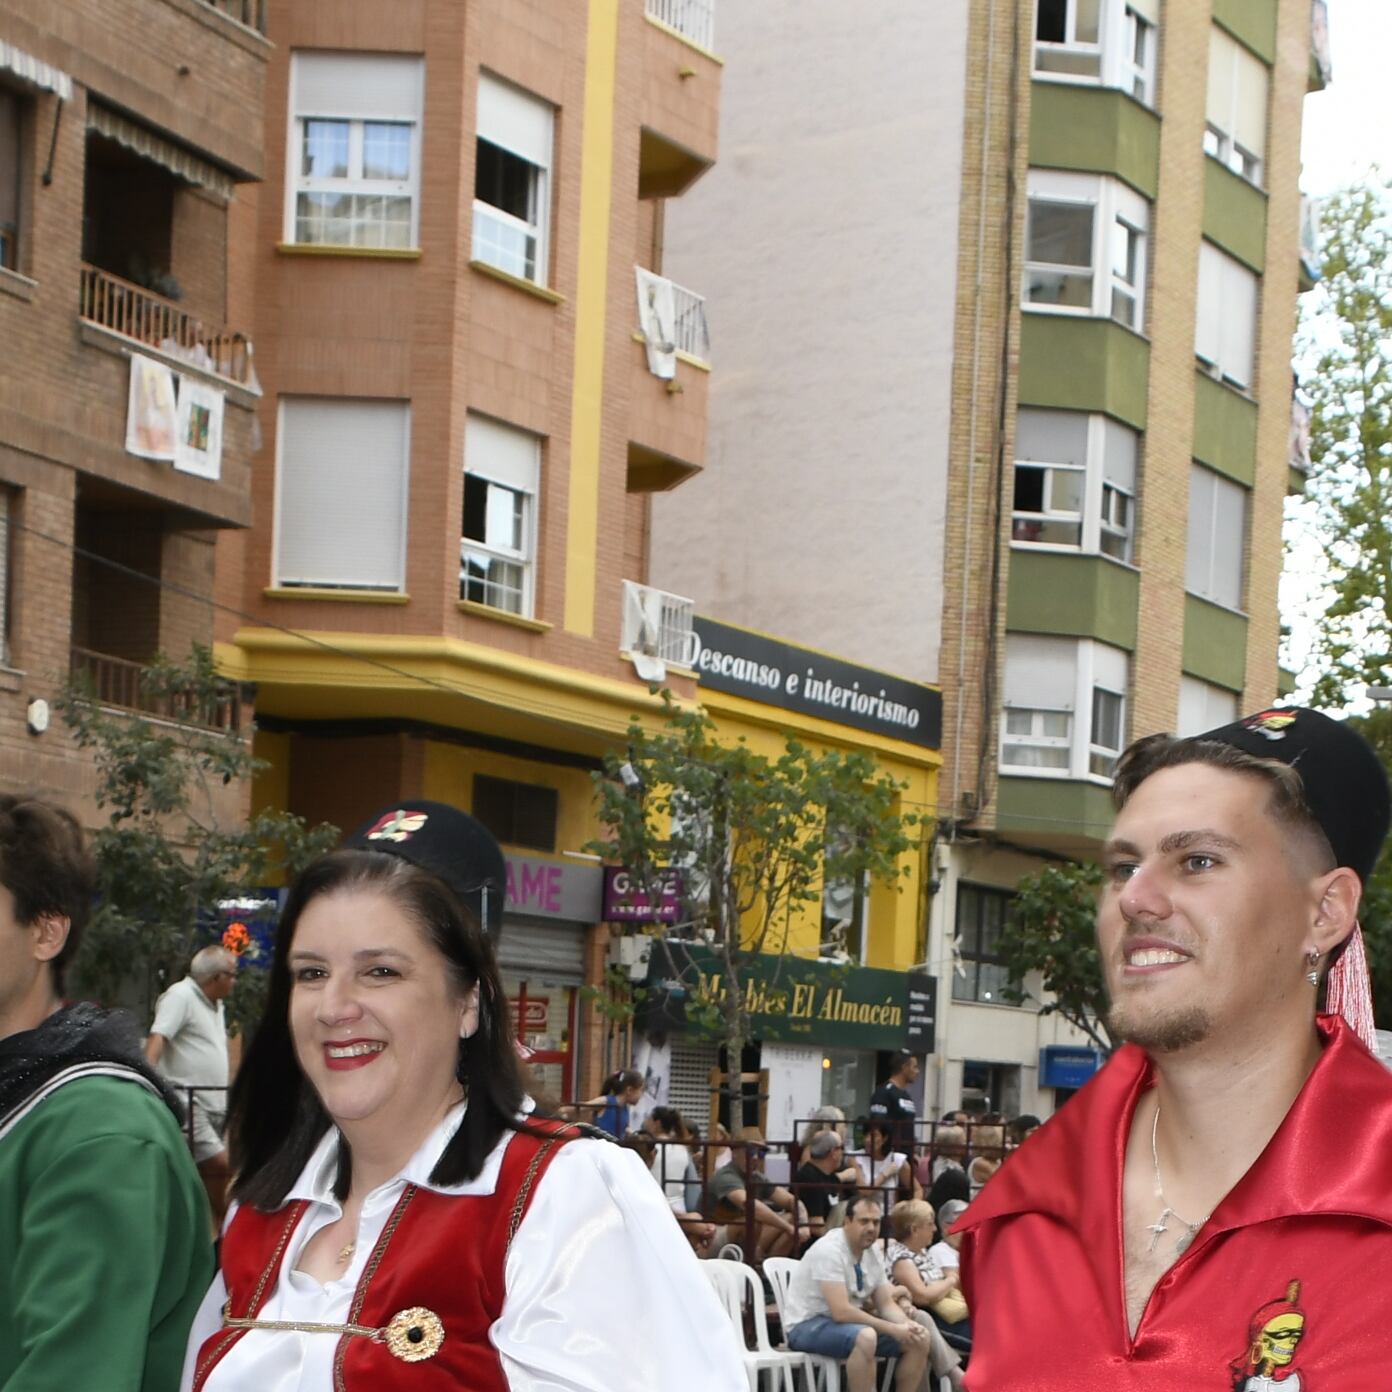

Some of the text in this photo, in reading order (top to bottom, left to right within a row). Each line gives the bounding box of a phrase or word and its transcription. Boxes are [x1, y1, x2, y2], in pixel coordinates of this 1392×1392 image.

[681, 630, 920, 729] Descanso e interiorismo
[505, 861, 563, 912] AME
[791, 983, 815, 1018] El
[818, 988, 903, 1027] Almacén
